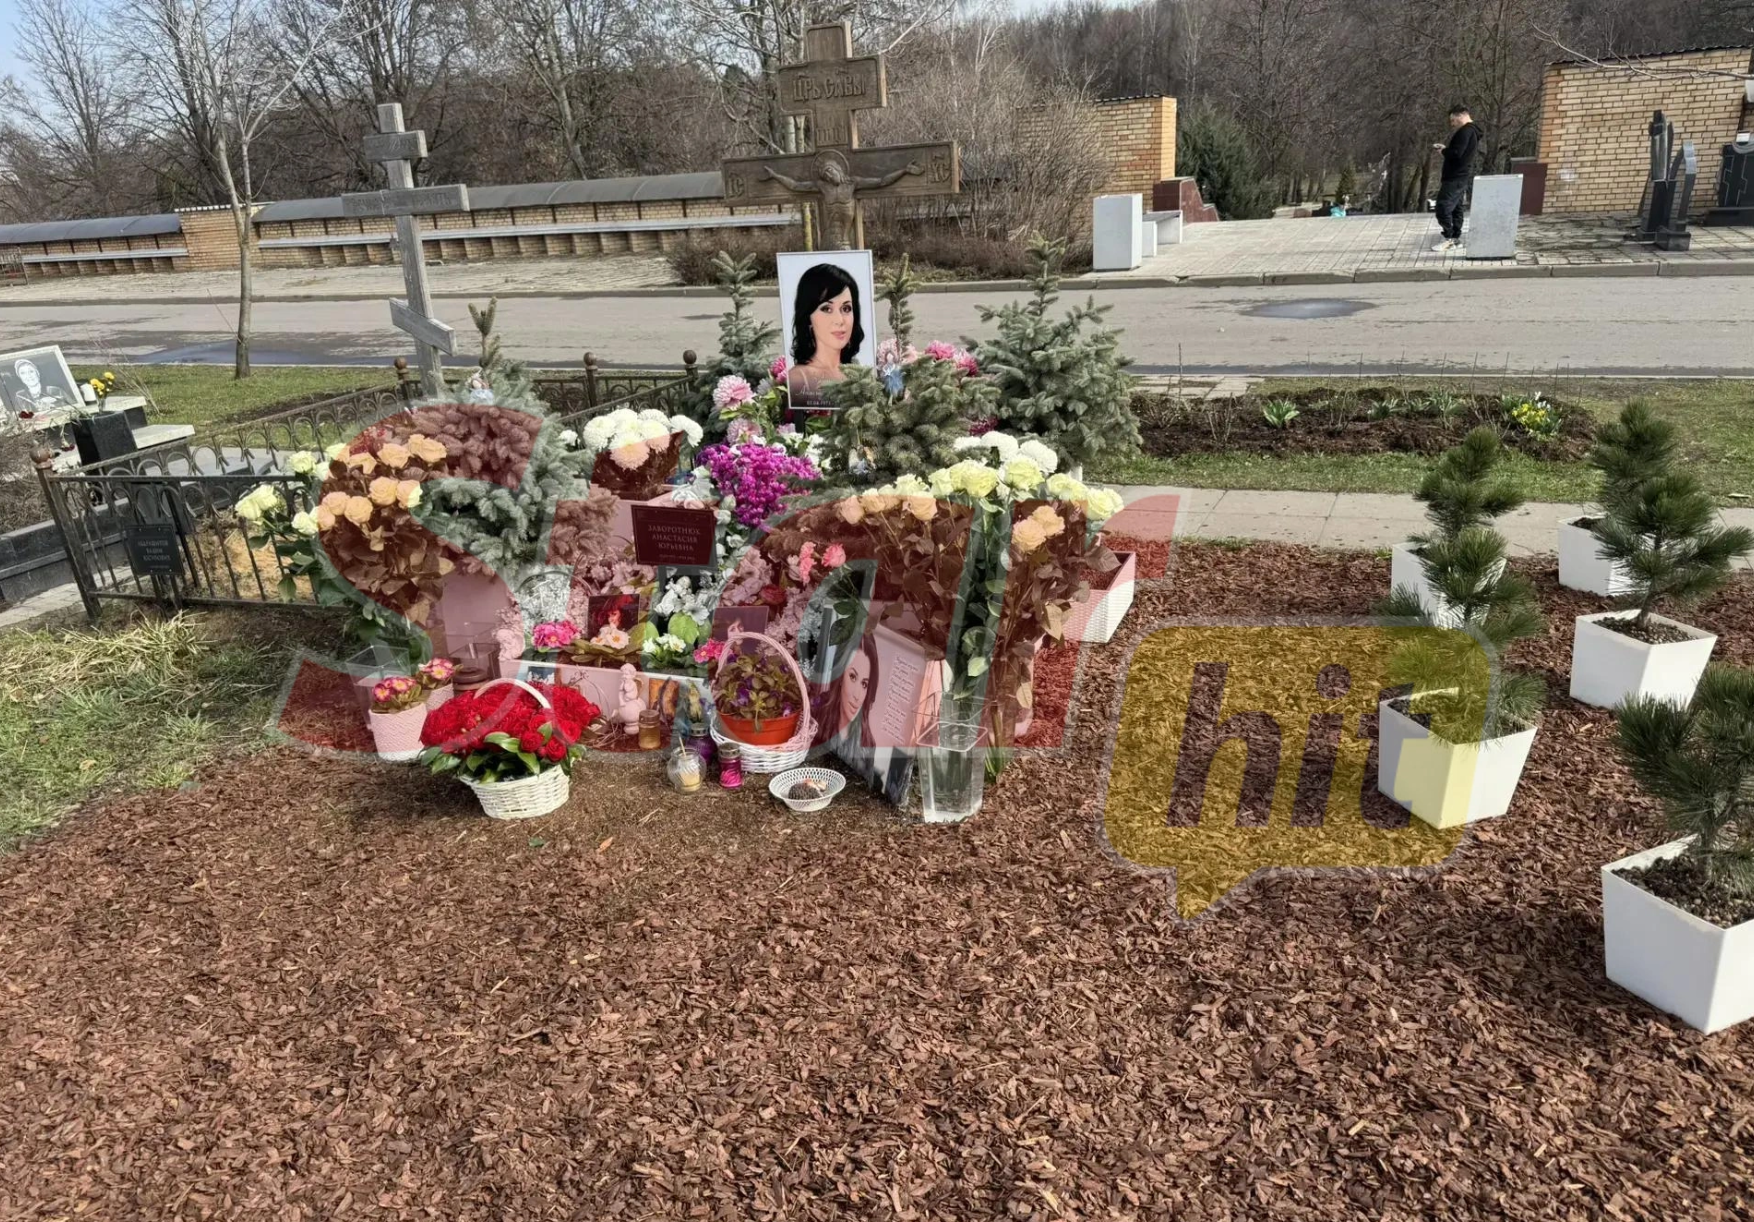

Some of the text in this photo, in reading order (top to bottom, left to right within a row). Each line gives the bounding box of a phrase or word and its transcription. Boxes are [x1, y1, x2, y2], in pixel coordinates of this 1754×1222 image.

[648, 524, 701, 535] ЗАВОРОТНЮК
[652, 533, 698, 544] АНАСТАСИЯ
[658, 542, 694, 551] ЮРЬЕВНА
